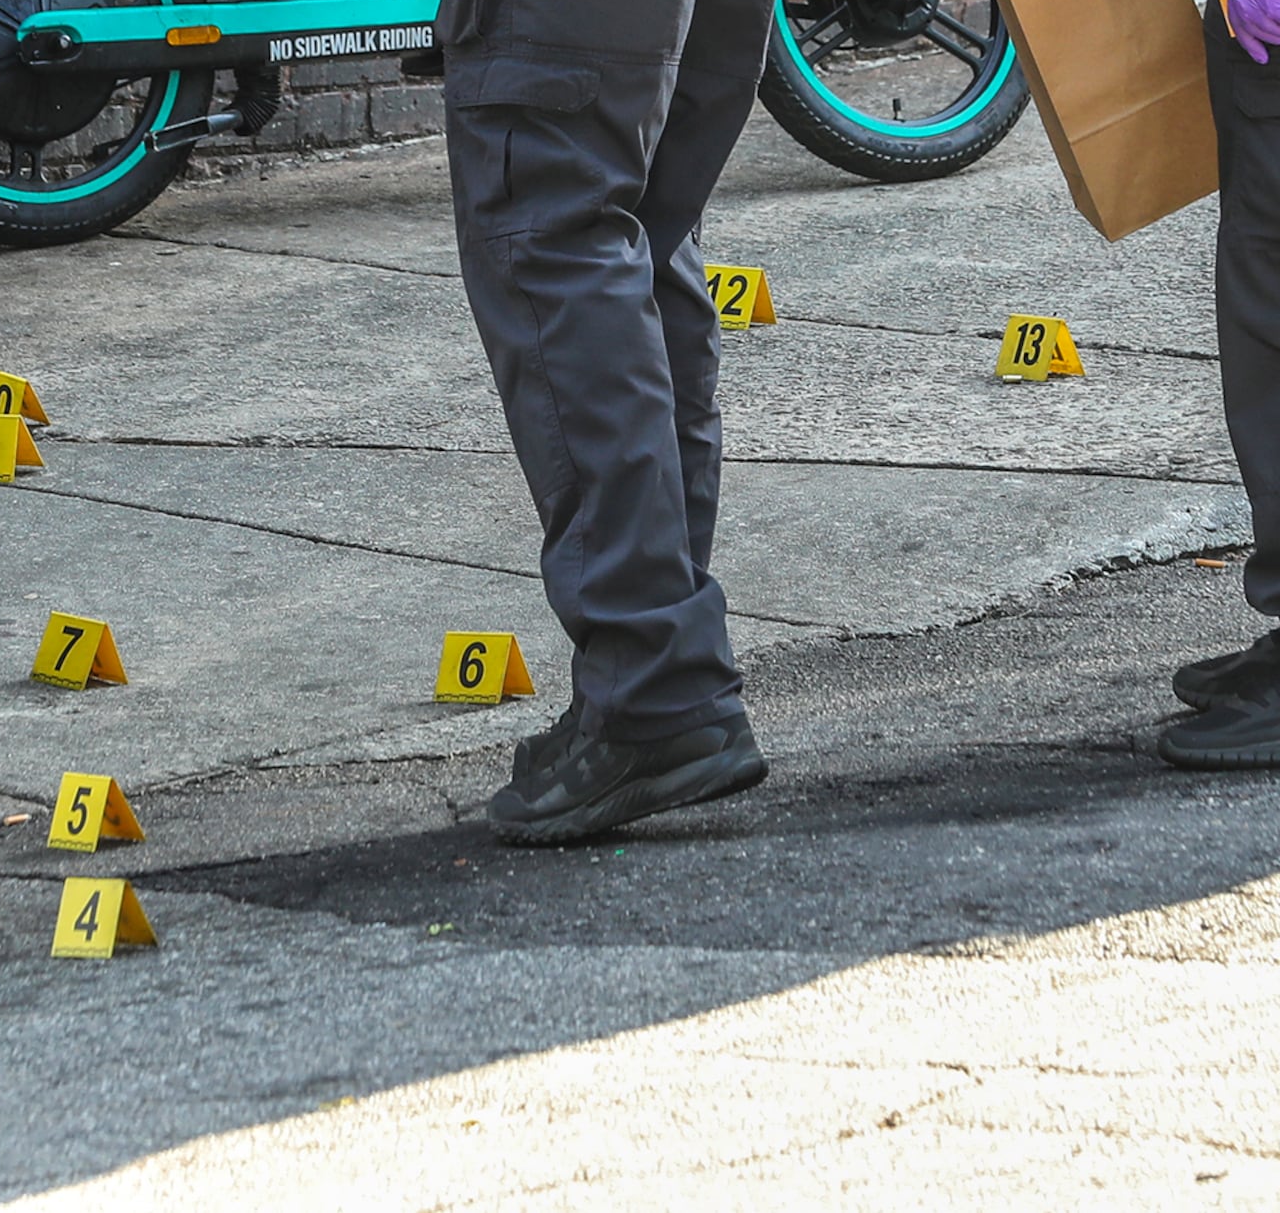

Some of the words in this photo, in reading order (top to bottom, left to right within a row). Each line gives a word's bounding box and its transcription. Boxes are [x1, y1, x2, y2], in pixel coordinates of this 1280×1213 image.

[270, 38, 293, 62] NO
[295, 30, 377, 59] SIDEWALK
[379, 26, 433, 51] RIDING
[707, 273, 748, 316] 12
[1012, 322, 1046, 366] 13
[53, 625, 85, 672] 7
[458, 641, 487, 689] 6
[66, 787, 93, 836] 5
[74, 890, 100, 941] 4
